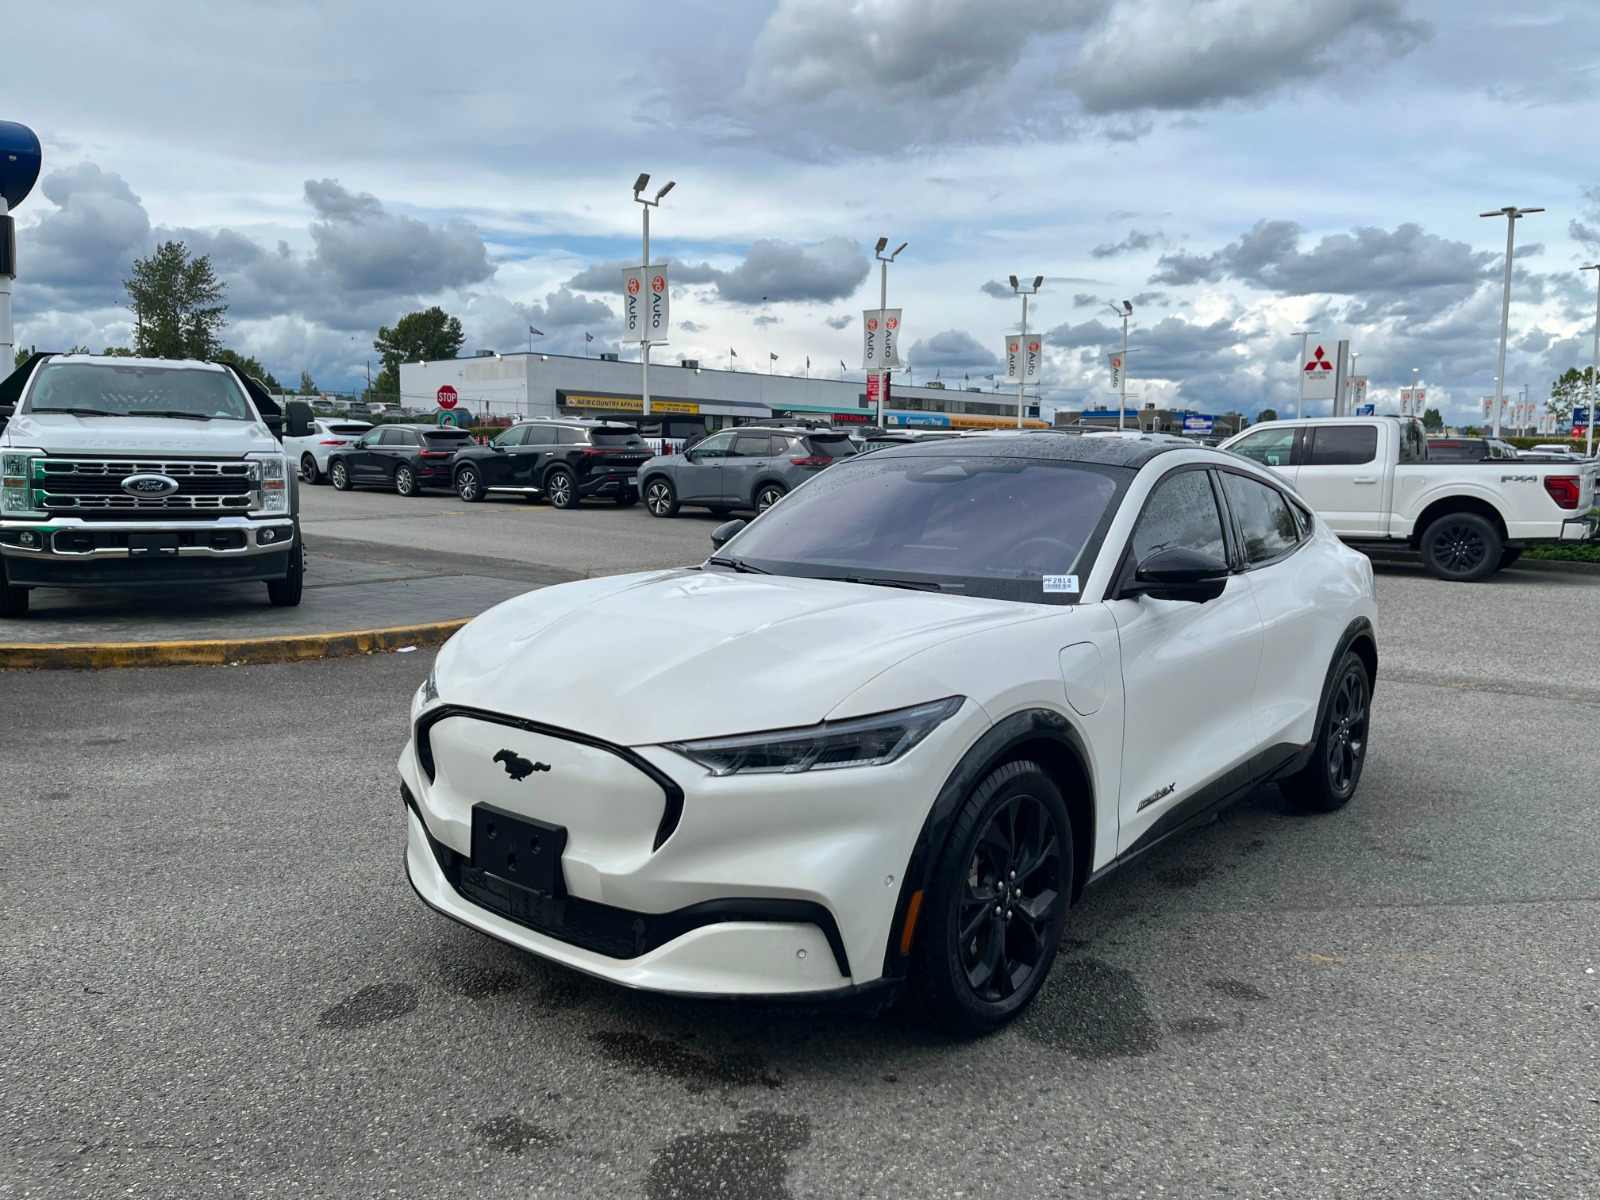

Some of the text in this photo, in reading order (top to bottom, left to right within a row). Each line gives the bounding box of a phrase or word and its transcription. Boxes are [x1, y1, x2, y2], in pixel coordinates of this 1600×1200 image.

[628, 295, 637, 330] Auto
[653, 293, 662, 328] Auto
[867, 331, 875, 359] Auto
[1028, 351, 1036, 375] Auto
[438, 392, 457, 402] STOP
[136, 480, 164, 490] Ford
